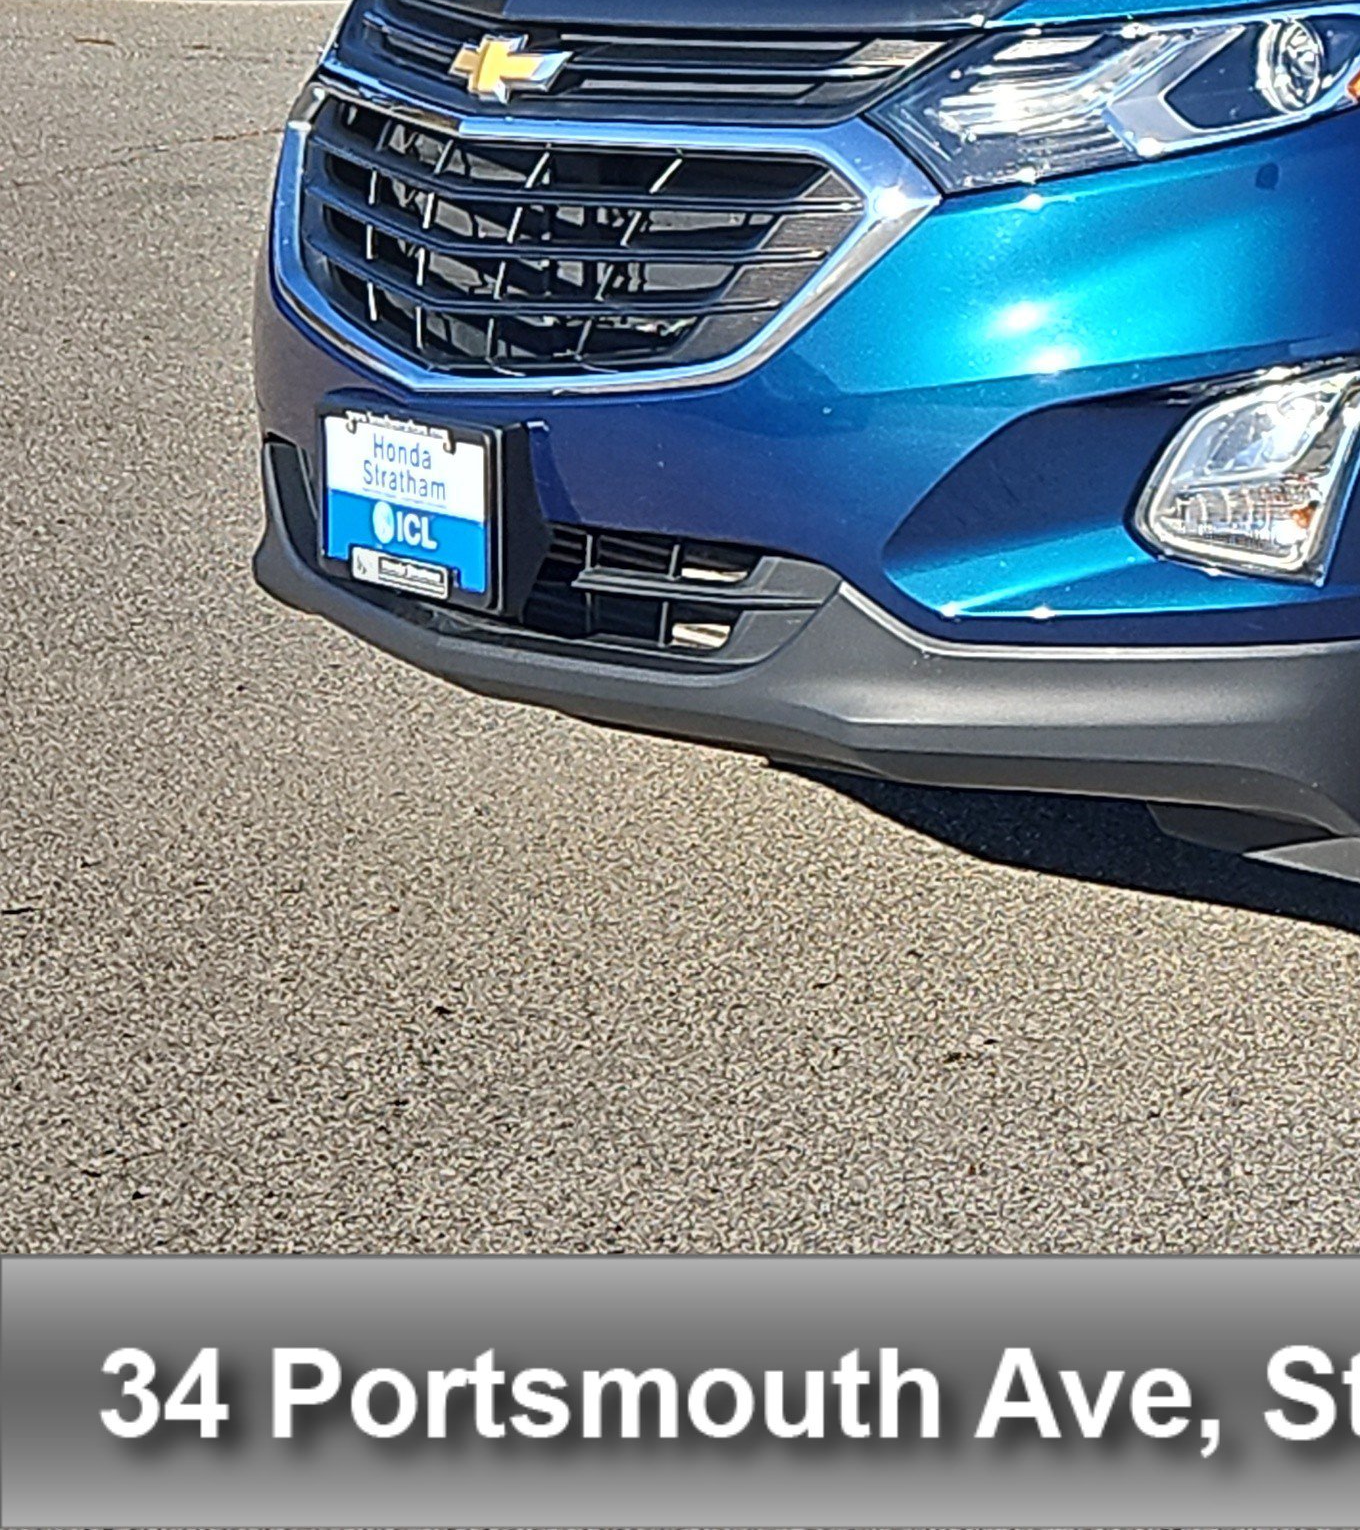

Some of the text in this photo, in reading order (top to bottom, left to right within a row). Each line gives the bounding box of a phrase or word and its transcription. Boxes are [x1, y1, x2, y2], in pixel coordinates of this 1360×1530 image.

[373, 433, 432, 470] Honda
[363, 459, 447, 501] Stratham
[396, 511, 438, 550] ICL
